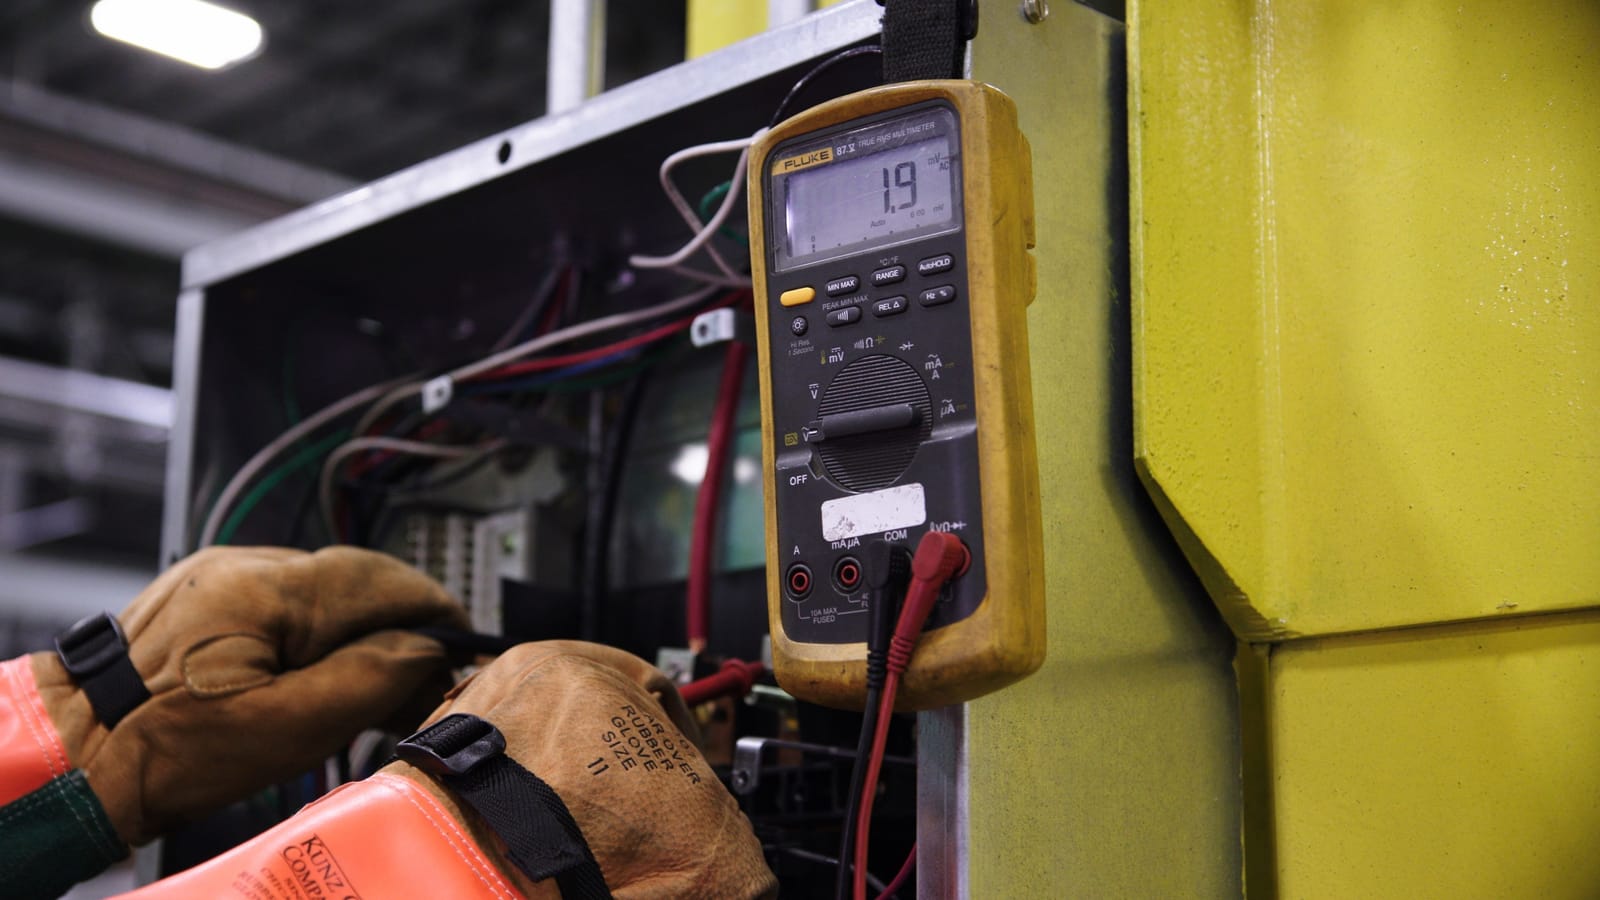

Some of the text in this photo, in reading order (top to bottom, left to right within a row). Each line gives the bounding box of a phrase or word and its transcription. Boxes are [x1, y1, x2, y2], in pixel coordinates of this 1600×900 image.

[784, 150, 830, 170] FLUKE
[858, 136, 875, 147] TRUE
[876, 131, 891, 143] RMS
[892, 121, 935, 139] MULTIMETER
[939, 159, 949, 171] AC
[883, 160, 917, 214] 1.9
[870, 218, 886, 229] Auto
[919, 257, 951, 272] AutoHOLD
[875, 268, 899, 281] RANGE
[827, 279, 855, 292] MIN MAX
[822, 293, 869, 311] PEAK MIN MAX
[926, 292, 936, 300] Hz
[878, 302, 891, 312] REL
[792, 345, 815, 356] Second
[828, 350, 844, 364] mV
[924, 357, 943, 370] mA
[931, 370, 940, 380] A
[789, 474, 808, 486] OFF
[884, 529, 908, 542] COM
[793, 545, 800, 555] A
[831, 538, 847, 550] mA
[810, 606, 838, 617] 10A MAX
[812, 614, 836, 624] FUSED
[611, 715, 658, 772] GLOVE
[621, 704, 675, 772] RUBBER
[602, 730, 638, 771] SIZE
[587, 756, 610, 776] 11
[663, 738, 701, 785] OVER
[301, 836, 344, 893] KUNZ
